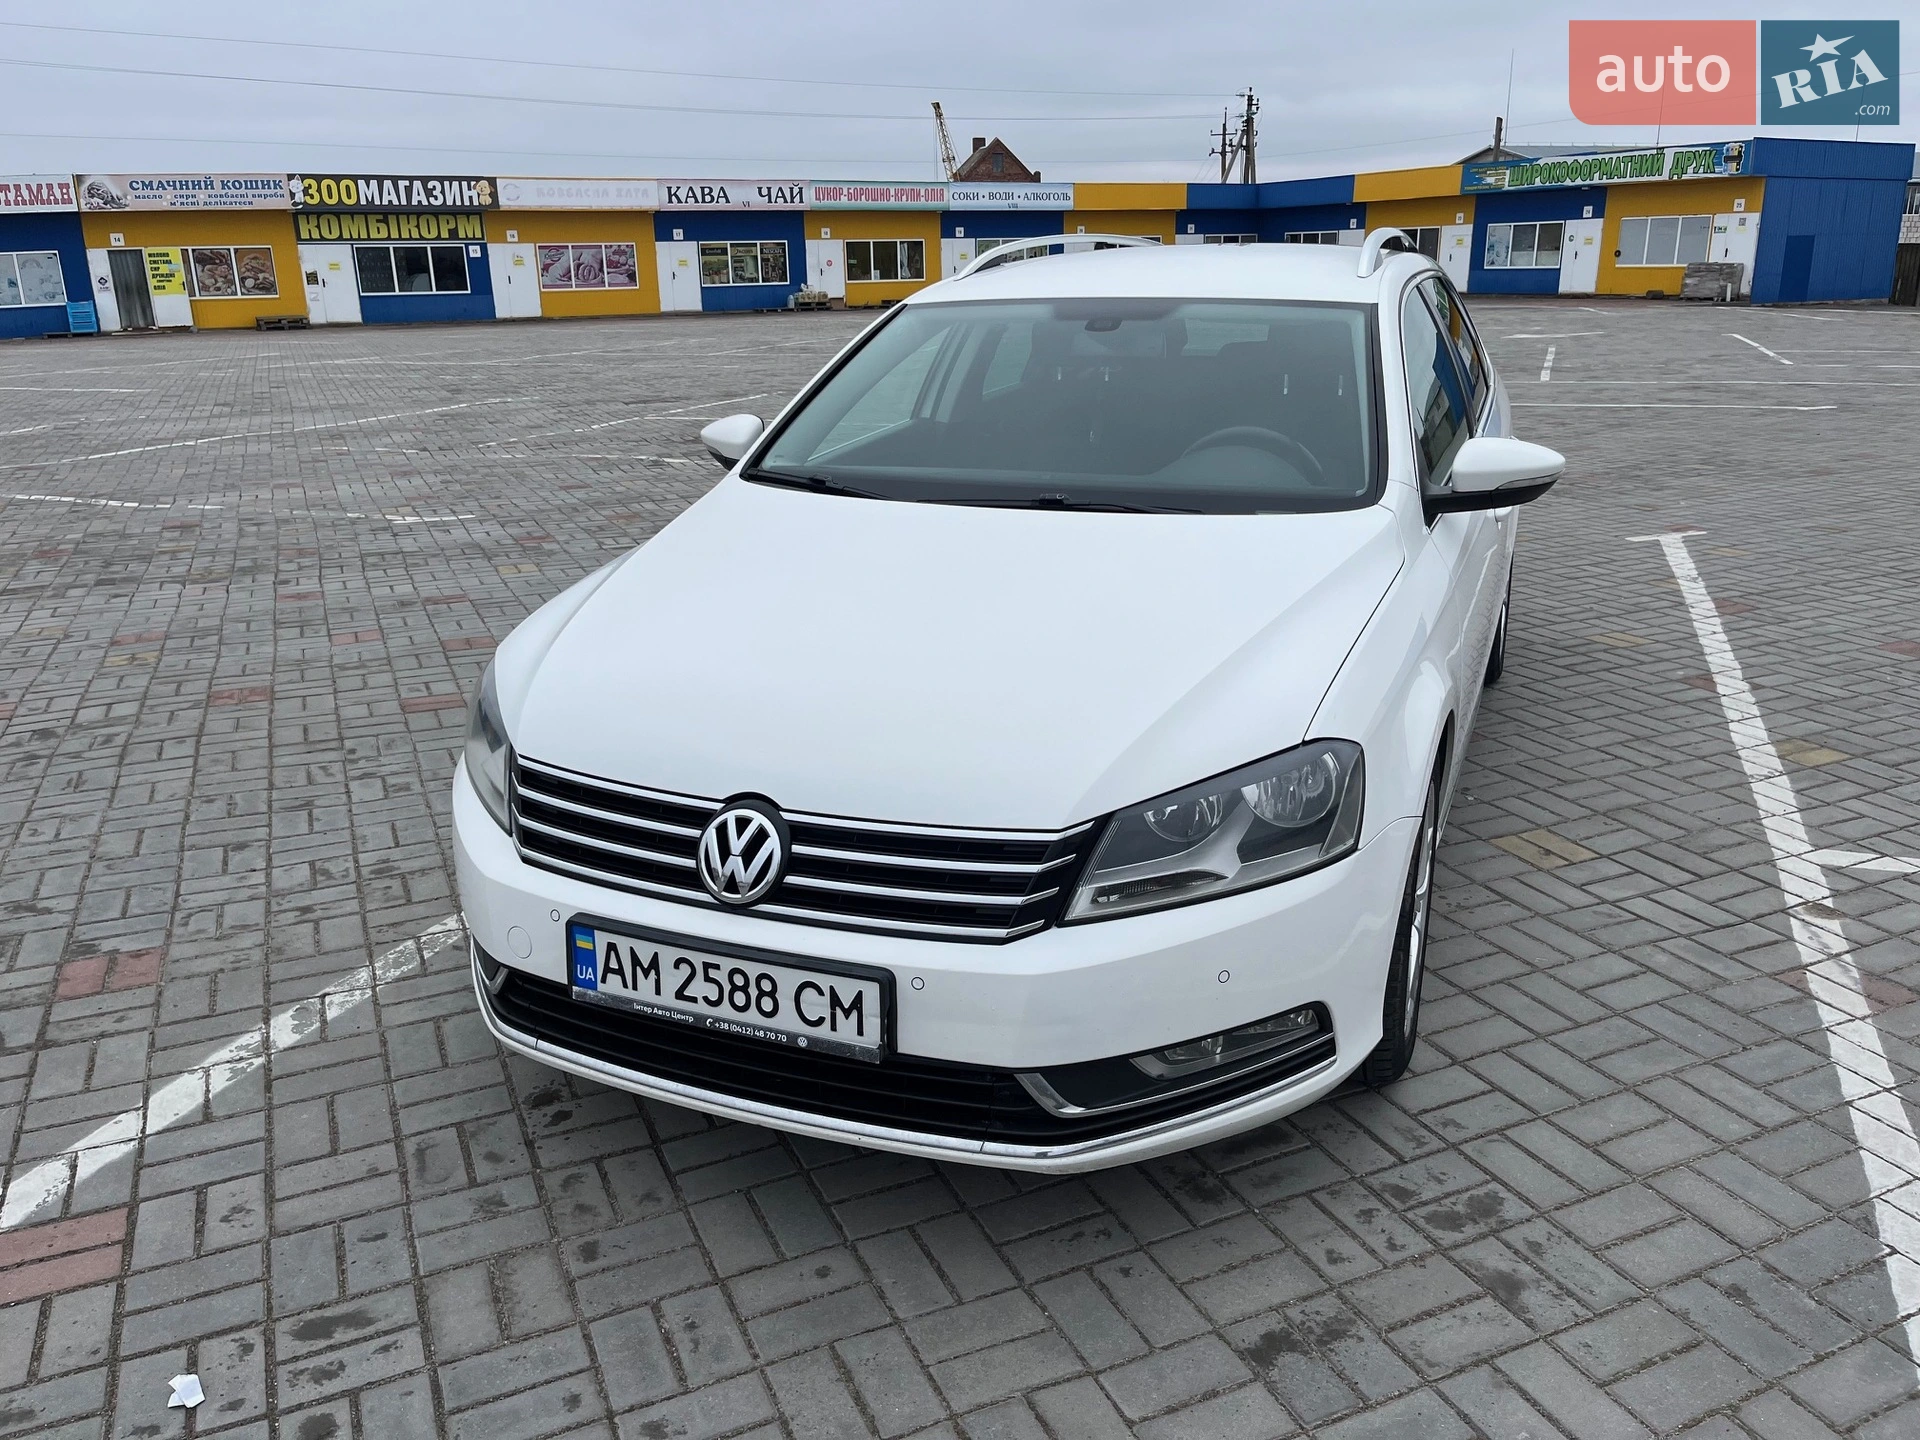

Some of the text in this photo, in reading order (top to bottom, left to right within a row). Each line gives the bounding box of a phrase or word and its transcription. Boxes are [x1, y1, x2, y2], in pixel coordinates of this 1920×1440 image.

[1508, 149, 1716, 188] ШИРОКОФОРМАТНИЙ ДРУК
[0, 182, 73, 206] ТАМАН
[129, 176, 284, 191] СМАЧНИЙ КОШИК
[303, 178, 480, 206] ЗООМАГАЗИН
[666, 182, 804, 204] КАВА ЧАЙ
[951, 191, 1071, 201] СОКИ ВОДИ АЛКОГОЛЬ
[298, 214, 482, 240] КОМБІКОРМ
[577, 964, 595, 982] UA
[600, 941, 864, 1037] AM 2588 CM
[633, 1003, 694, 1023] Інтер Авто Центр
[714, 1022, 787, 1042] +38 (0412) 48 70 70
